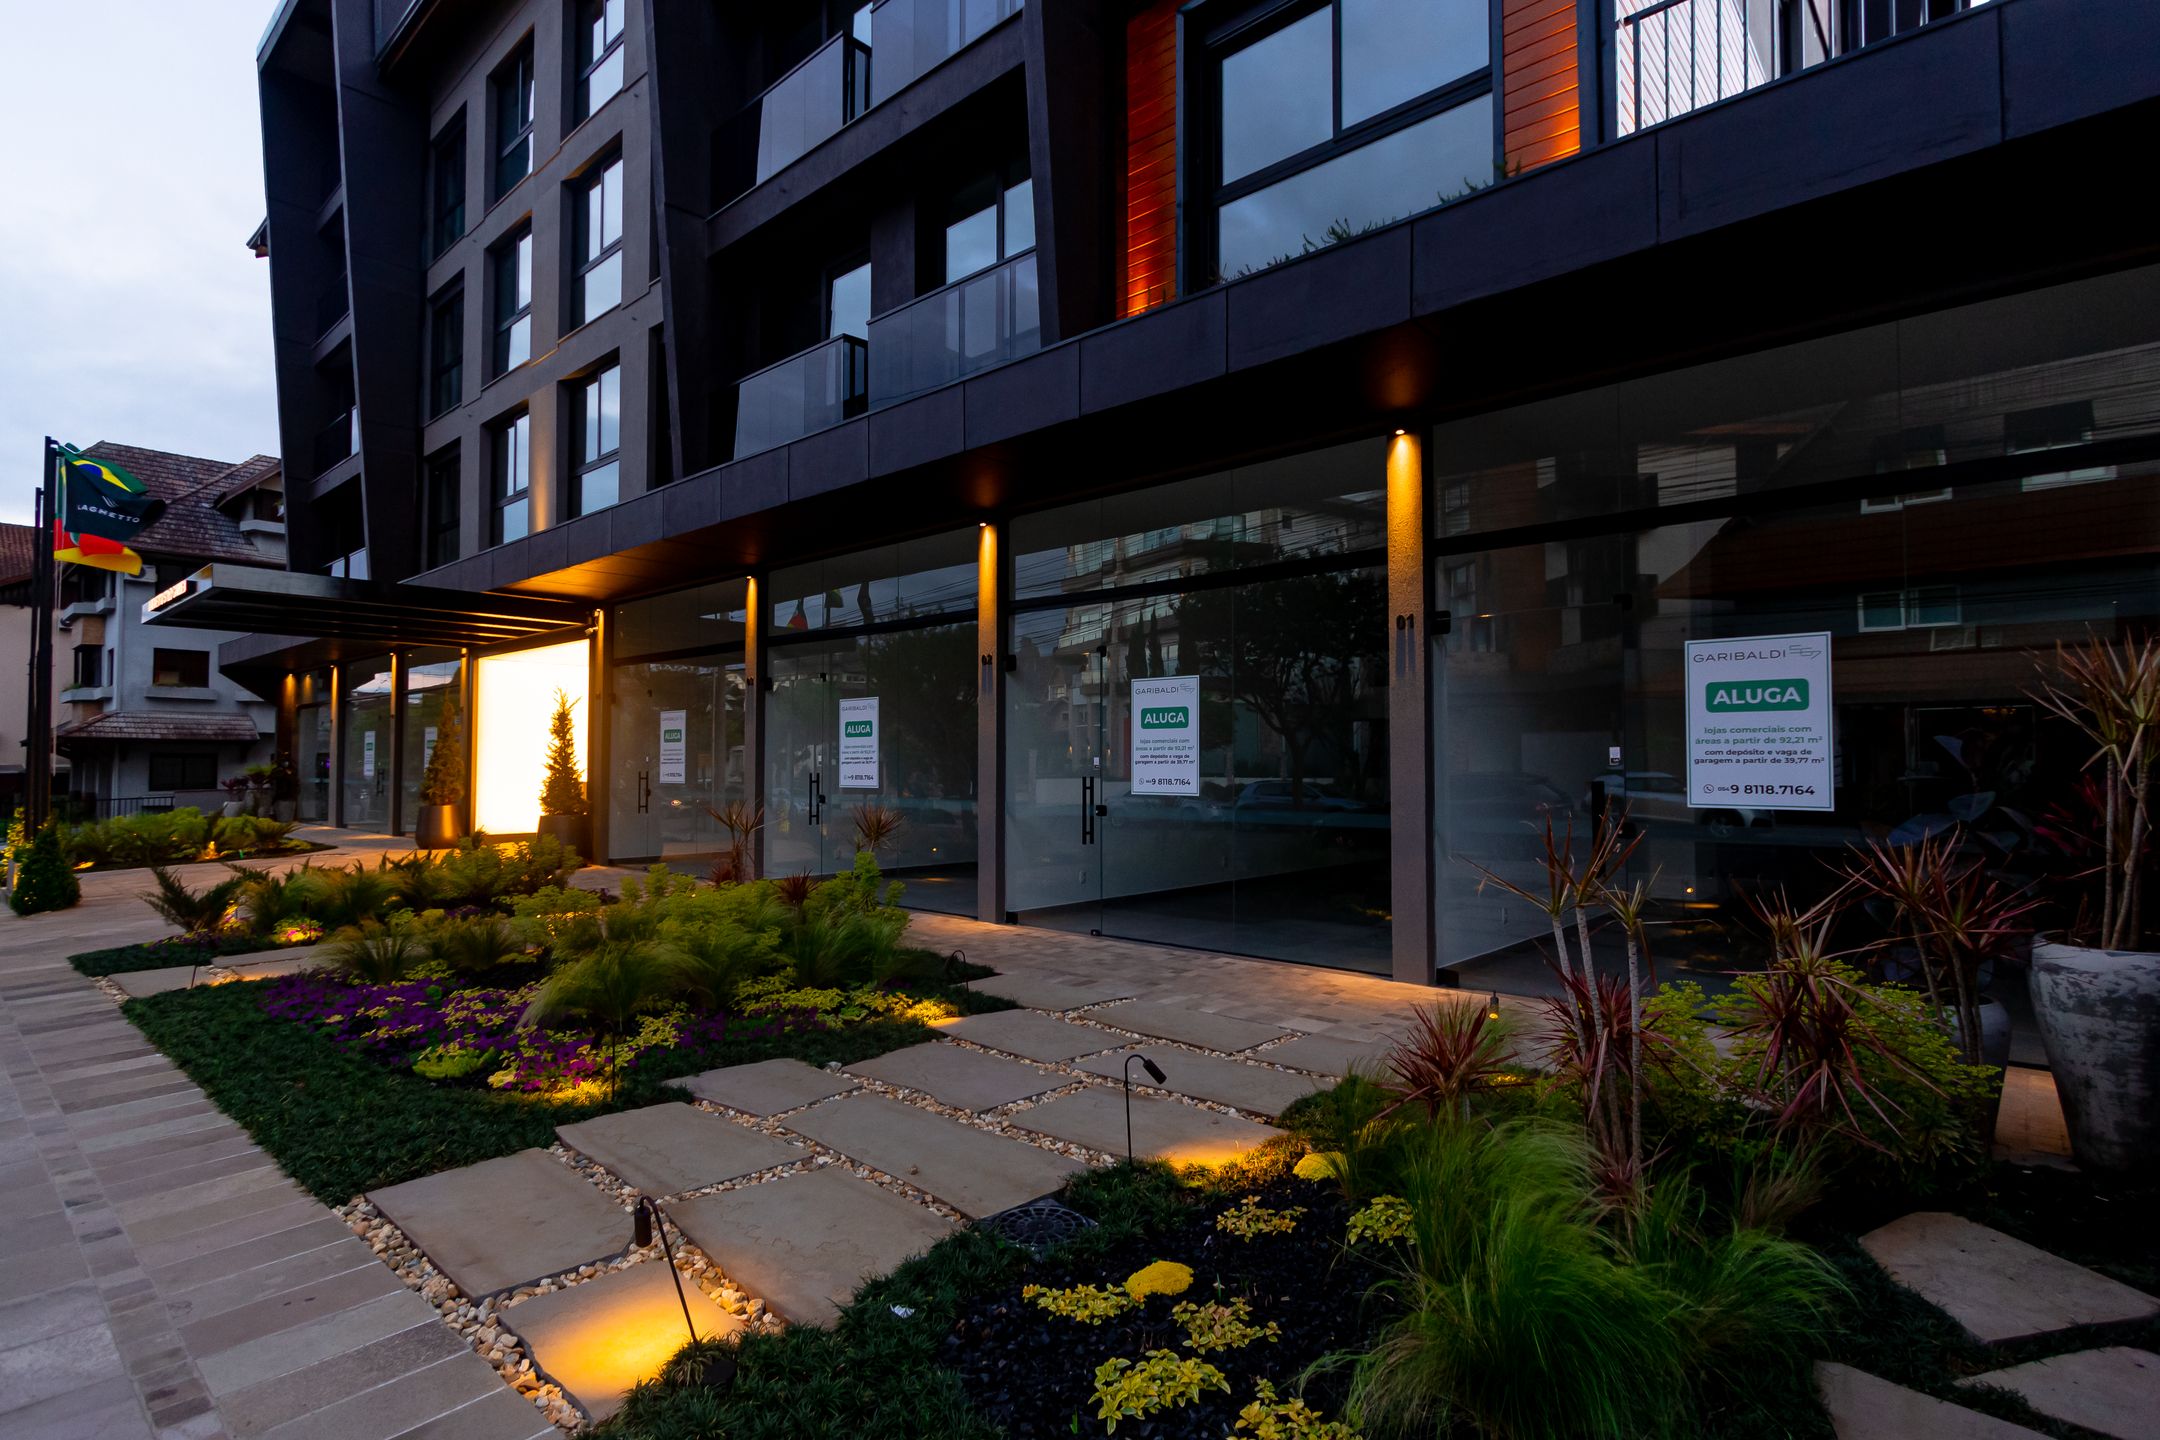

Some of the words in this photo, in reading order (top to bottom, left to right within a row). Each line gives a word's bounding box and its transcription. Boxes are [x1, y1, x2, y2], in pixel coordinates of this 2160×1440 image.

[1693, 649, 1786, 663] GARIBALDI
[1135, 686, 1179, 695] GARIBALDI
[1713, 686, 1801, 705] ALUGA
[1144, 712, 1185, 724] ALUGA
[847, 724, 871, 734] ALUGA
[1704, 726, 1727, 735] lojas
[1729, 725, 1785, 734] comerciais
[1695, 736, 1721, 745] áreas
[1733, 736, 1760, 746] partir
[1763, 735, 1777, 744] de
[1779, 735, 1804, 745] 92,21
[1726, 748, 1765, 757] depósito
[1775, 749, 1798, 757] vaga
[1694, 757, 1733, 765] garagem
[1743, 757, 1768, 765] partir
[1784, 757, 1808, 765] 39,77
[1744, 784, 1815, 795] 8118.7164
